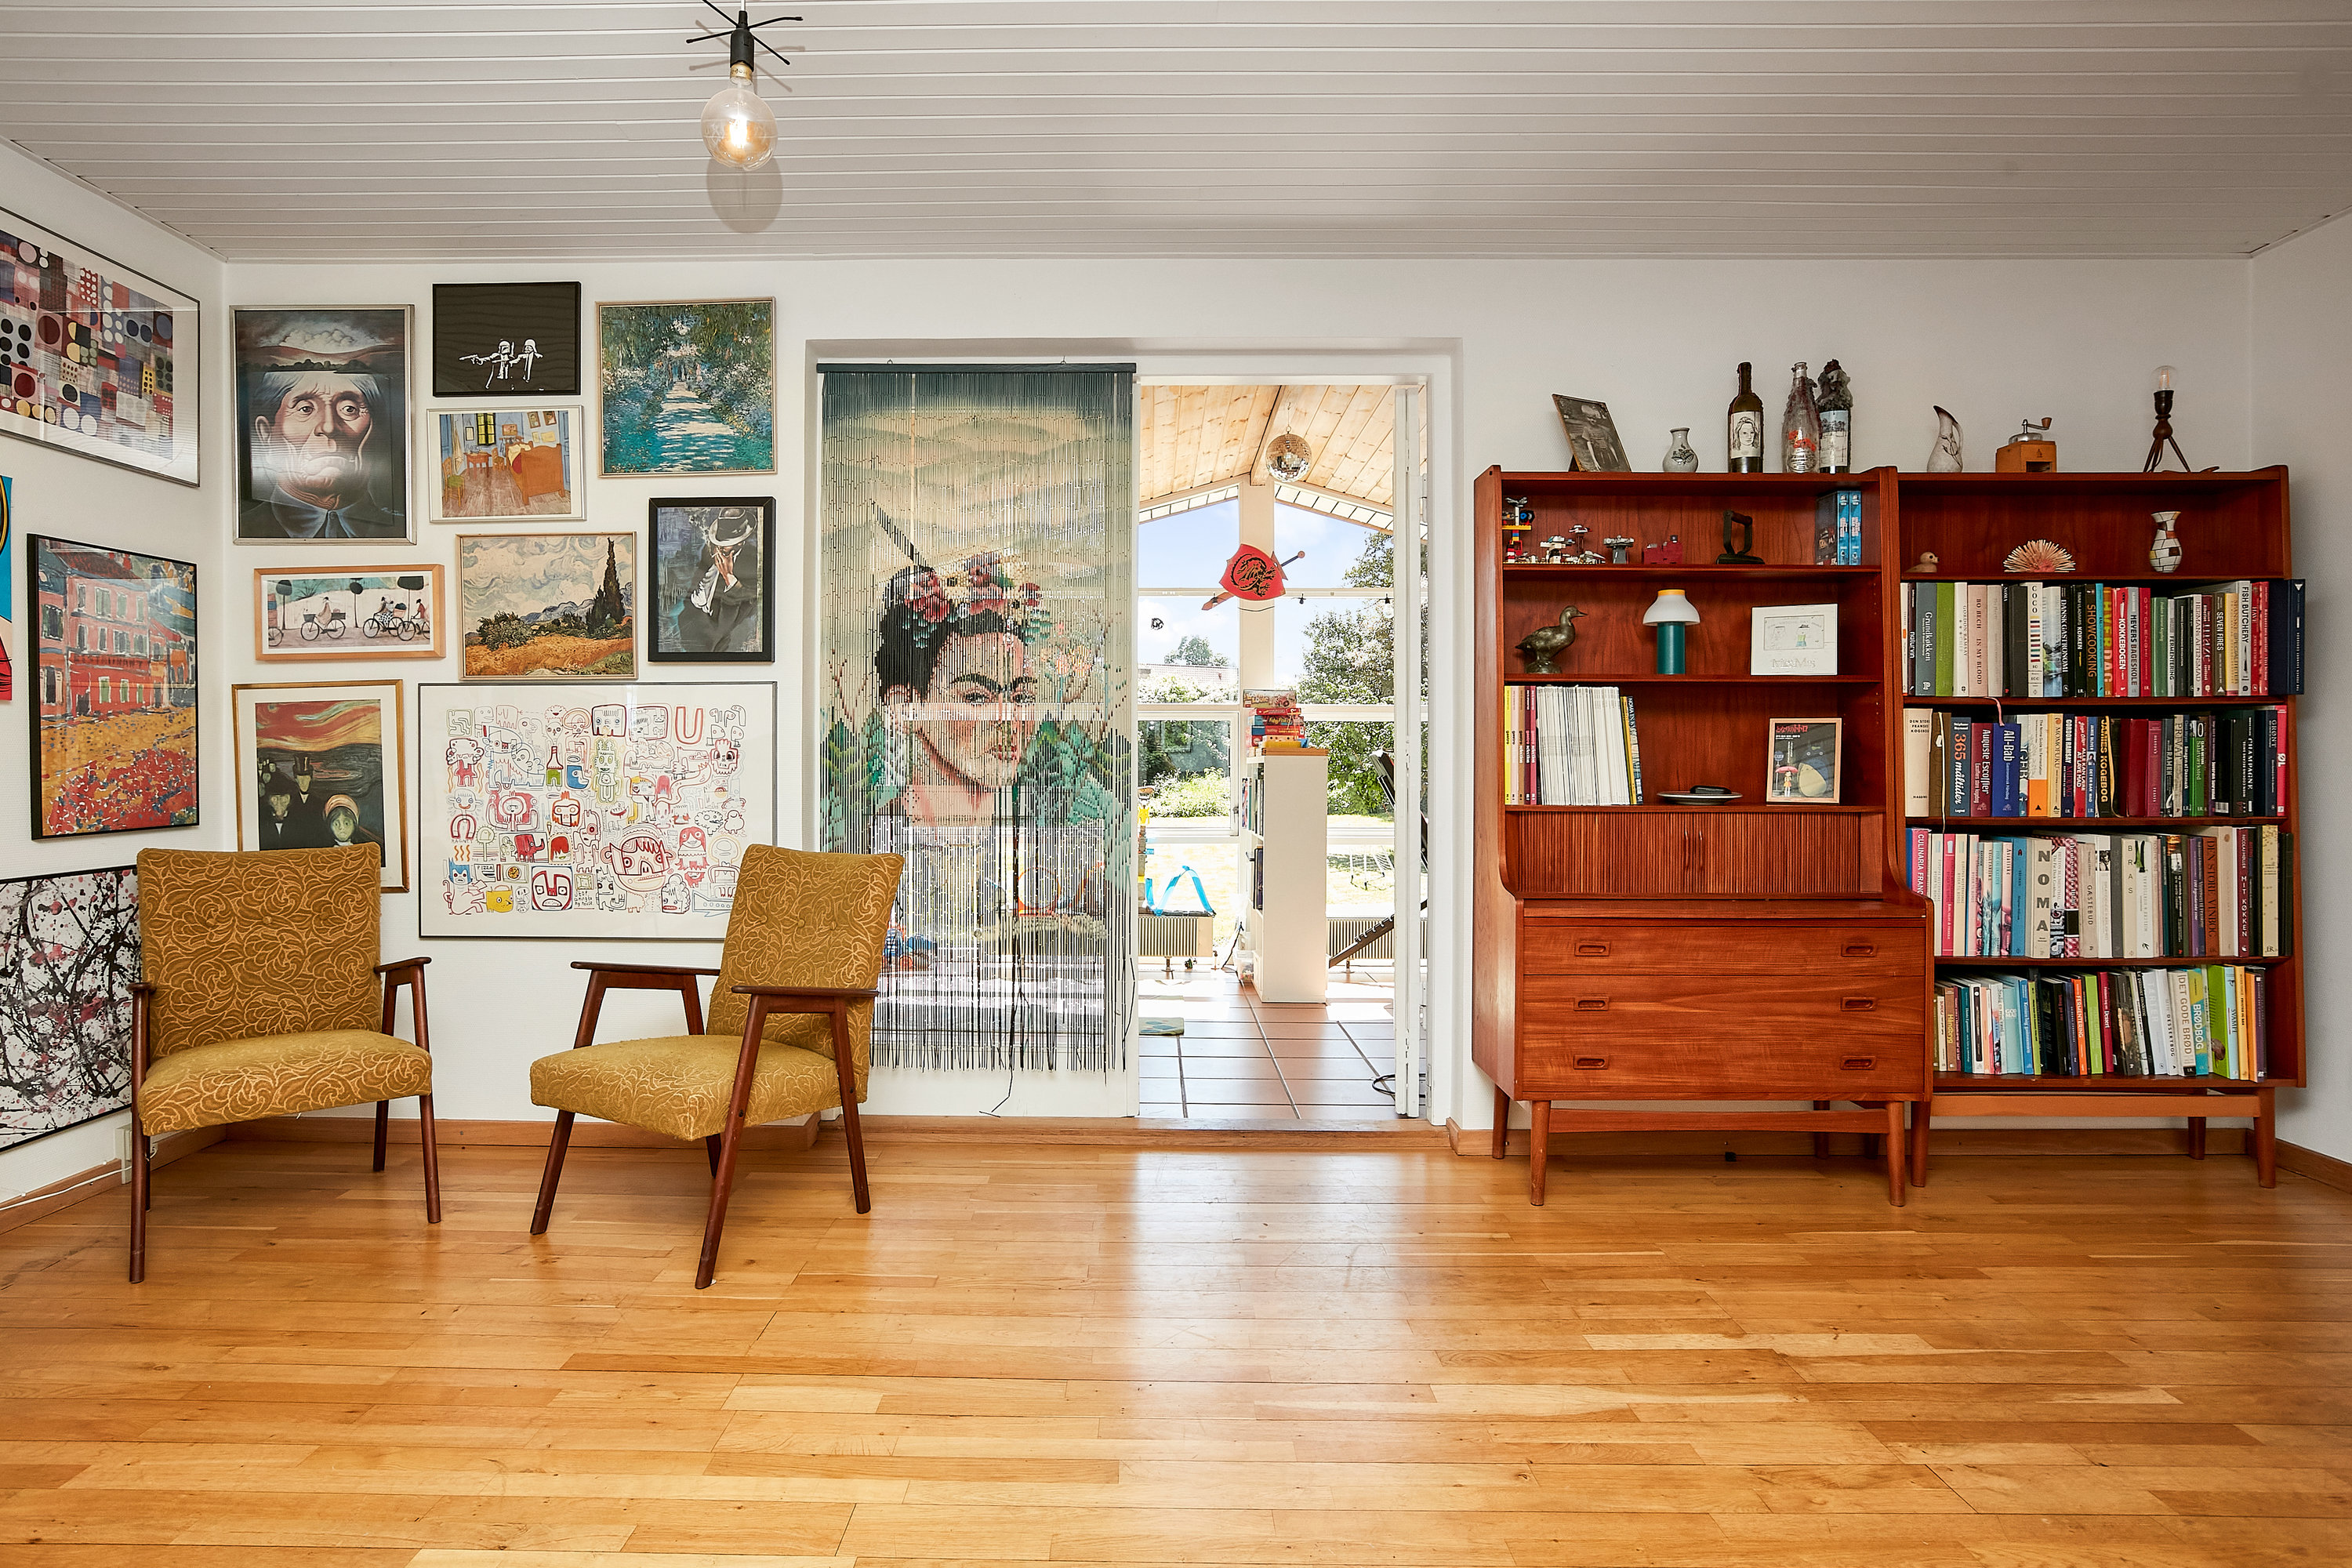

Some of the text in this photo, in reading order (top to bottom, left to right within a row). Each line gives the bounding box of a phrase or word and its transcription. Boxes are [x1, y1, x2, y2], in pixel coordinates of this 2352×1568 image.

[1976, 599, 1981, 608] BO
[1976, 649, 1982, 659] MY
[2087, 604, 2096, 677] SHOWCOOKING
[1954, 734, 1966, 804] 365 måltider
[1980, 729, 1991, 795] Auguste Escoffier
[2004, 730, 2015, 762] Ali-Bab
[2278, 753, 2285, 768] ØL
[2037, 850, 2050, 931] NOMA
[2208, 840, 2216, 937] DEN STORE VINBOG
[2166, 1013, 2175, 1057] DESSERTBOG
[2178, 977, 2192, 1054] DET GODE BRØD
[2193, 1004, 2204, 1049] BRØDBOG
